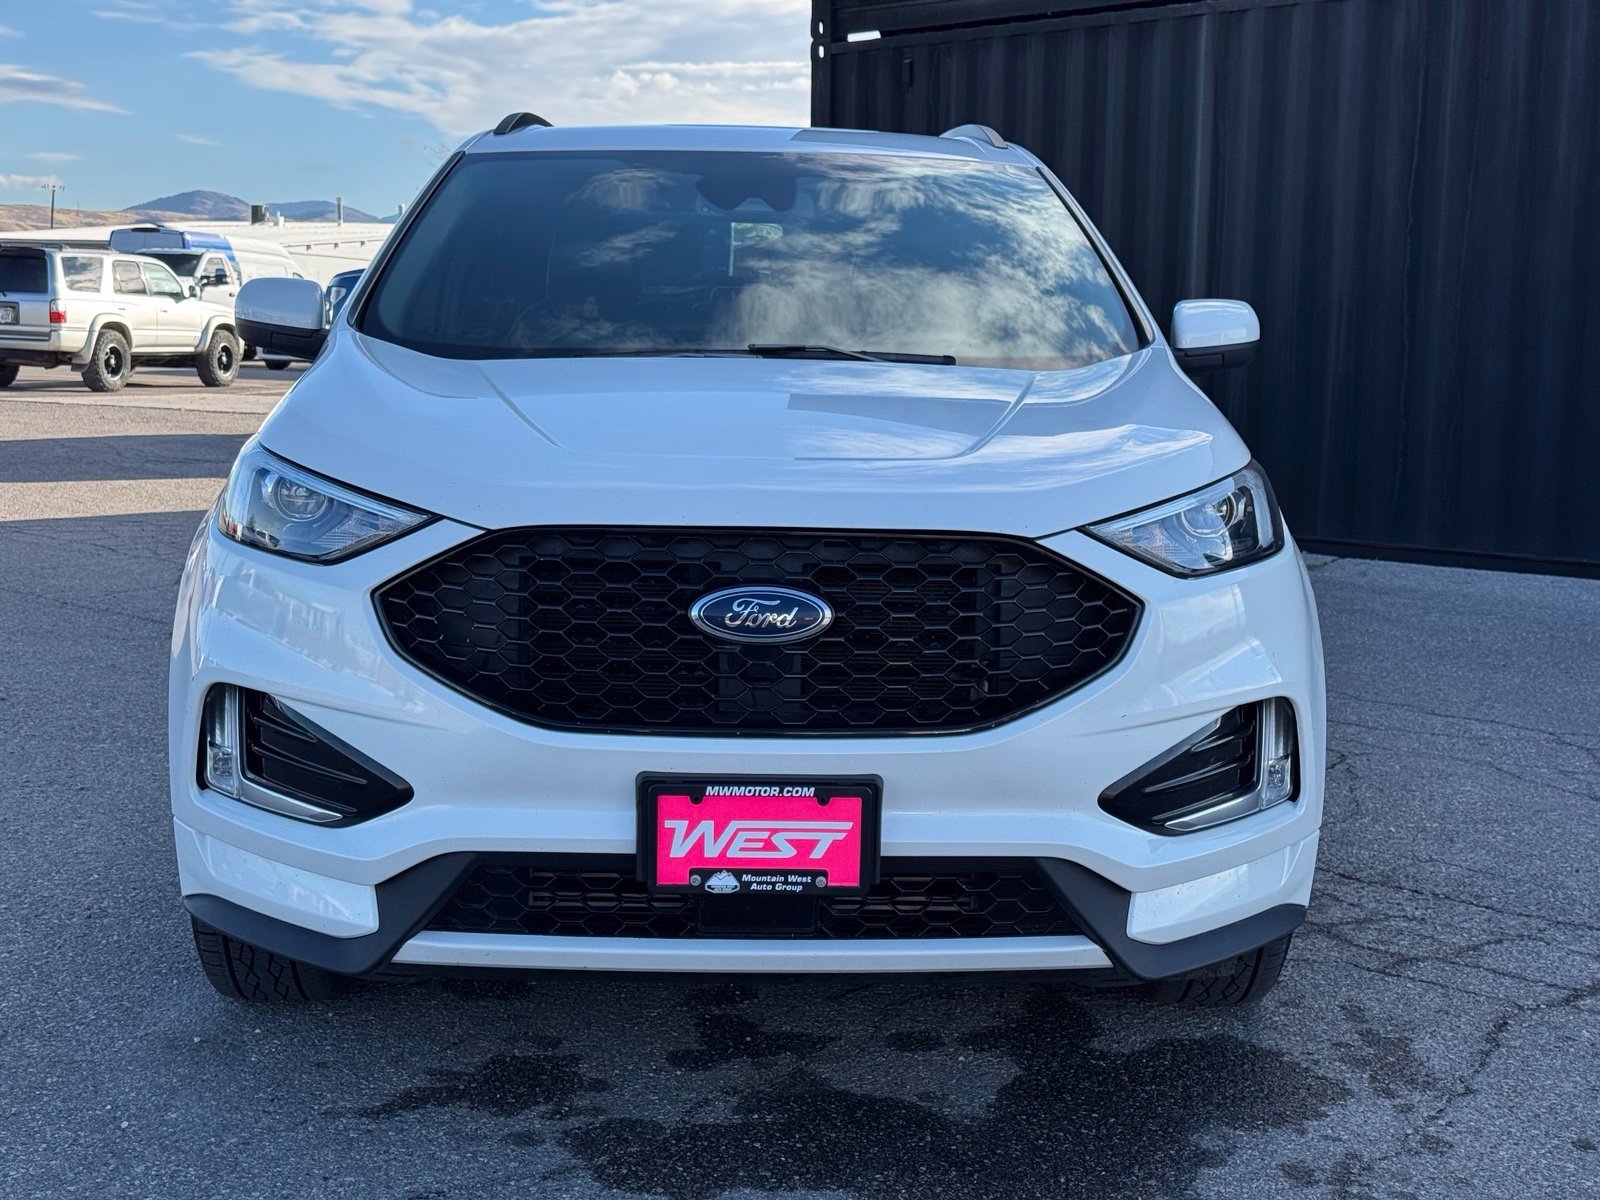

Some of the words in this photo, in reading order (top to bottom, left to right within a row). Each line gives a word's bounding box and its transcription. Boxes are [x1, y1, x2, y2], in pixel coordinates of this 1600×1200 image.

[725, 598, 799, 628] Ford
[705, 786, 815, 797] MWMOTOR.COM
[664, 820, 854, 859] WEST
[742, 874, 785, 883] Mountain
[788, 875, 812, 883] West
[750, 883, 773, 891] Auto
[775, 883, 803, 893] Group
